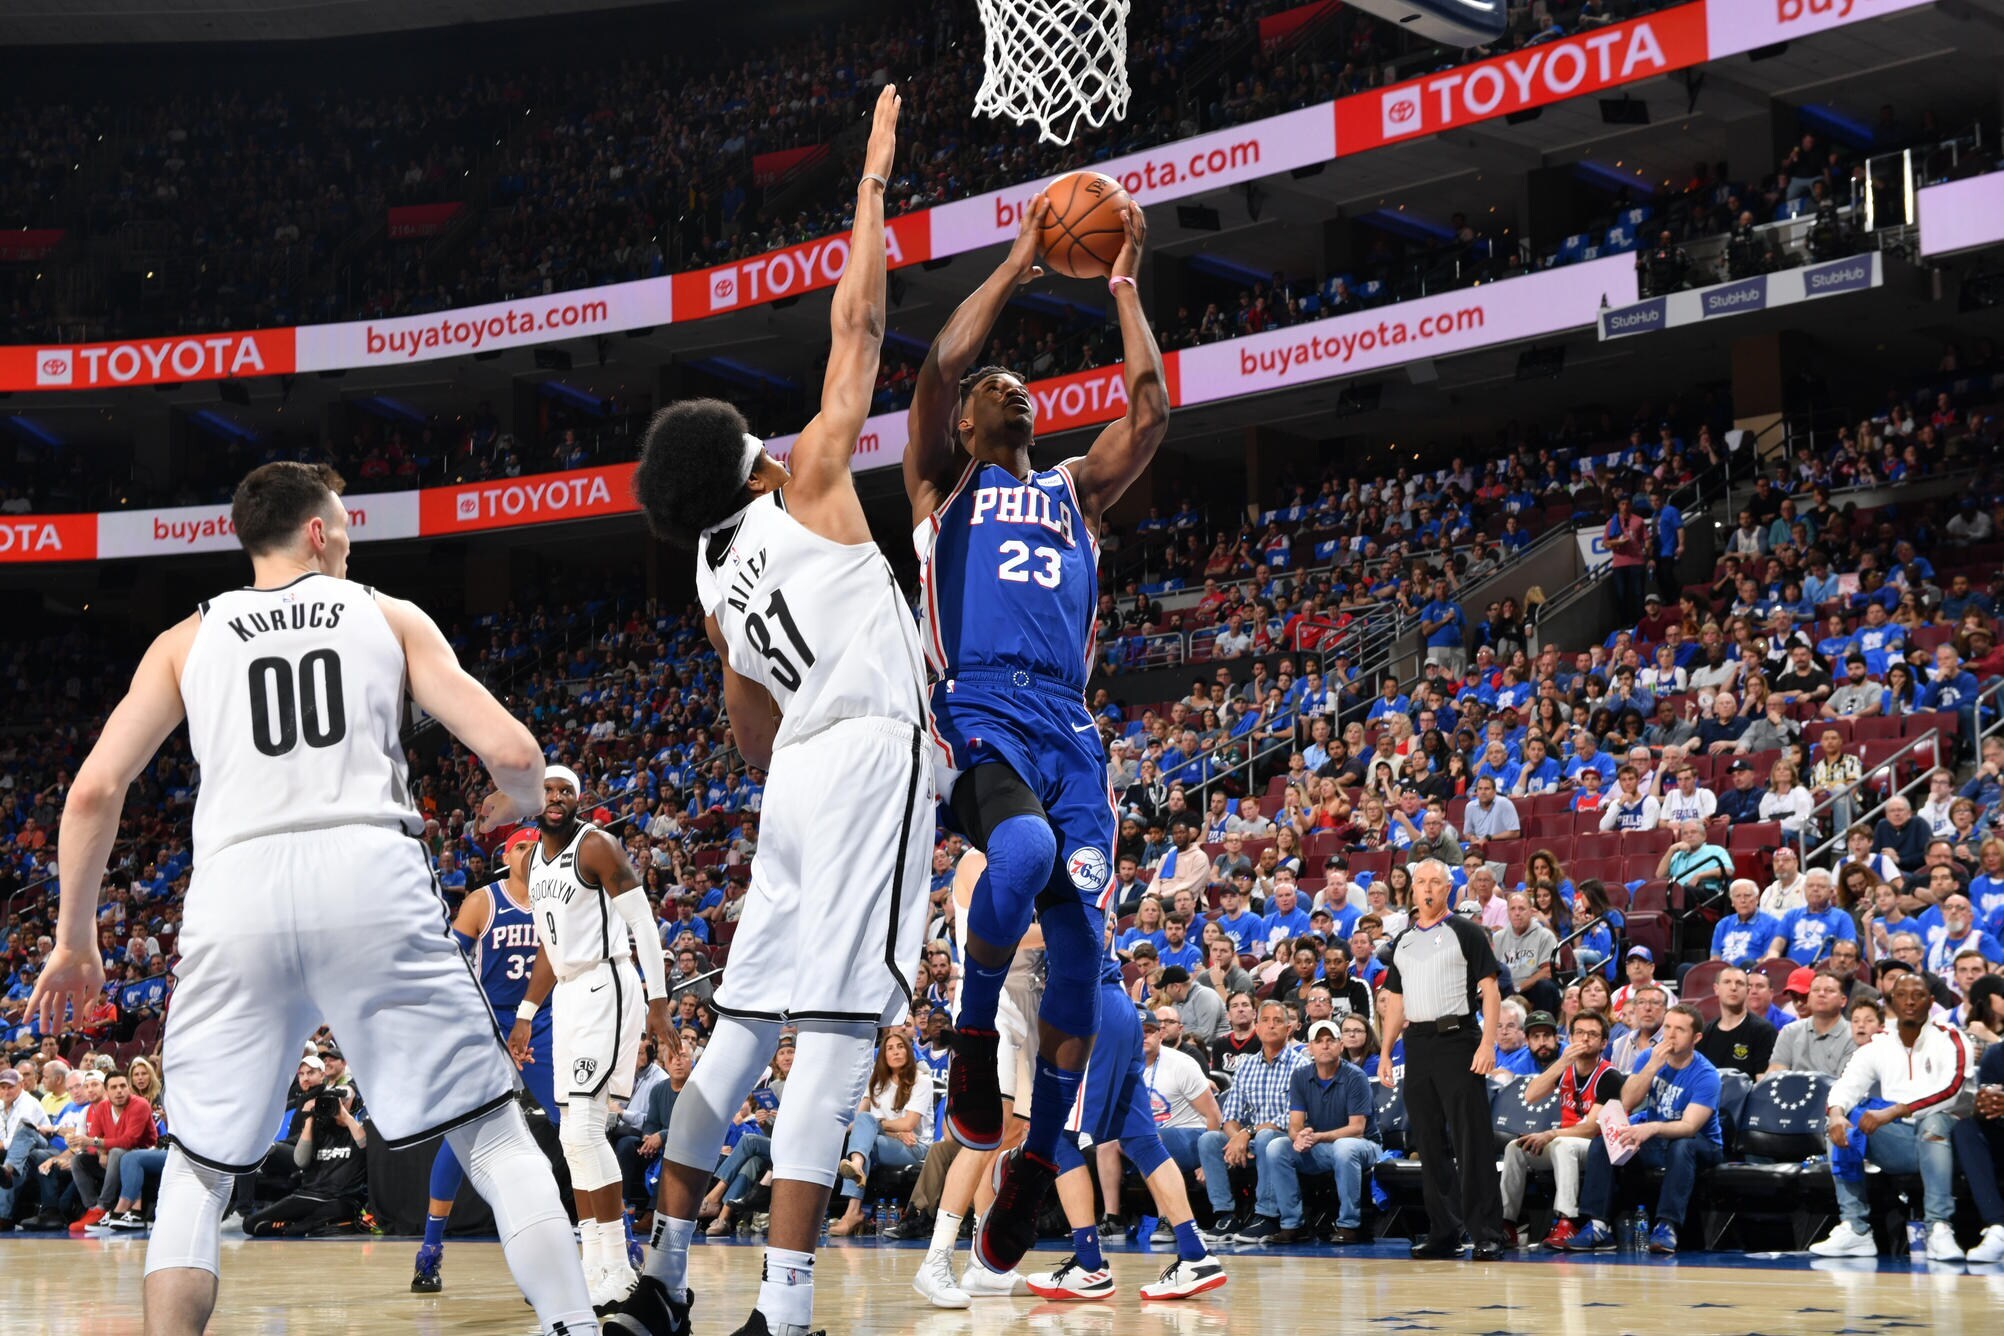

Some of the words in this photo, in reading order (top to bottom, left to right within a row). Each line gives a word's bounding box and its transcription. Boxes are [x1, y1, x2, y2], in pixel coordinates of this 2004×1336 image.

[1428, 23, 1666, 125] TOYOTA
[742, 226, 903, 300] TOYOA
[1811, 267, 1865, 288] StubHub
[1610, 309, 1660, 329] StubHub
[1708, 287, 1760, 309] StubHub
[366, 299, 608, 358] buyatoyota.com
[1240, 304, 1485, 376] buyatoyota.com
[80, 336, 265, 383] TOYOTA
[1031, 374, 1128, 421] YOTA
[484, 476, 611, 517] TOYOTA
[970, 485, 1076, 548] PHILA
[999, 540, 1062, 589] 23
[228, 602, 345, 642] KURUCS
[745, 588, 816, 692] 31
[248, 648, 346, 757] 00
[491, 924, 541, 950] PHIL
